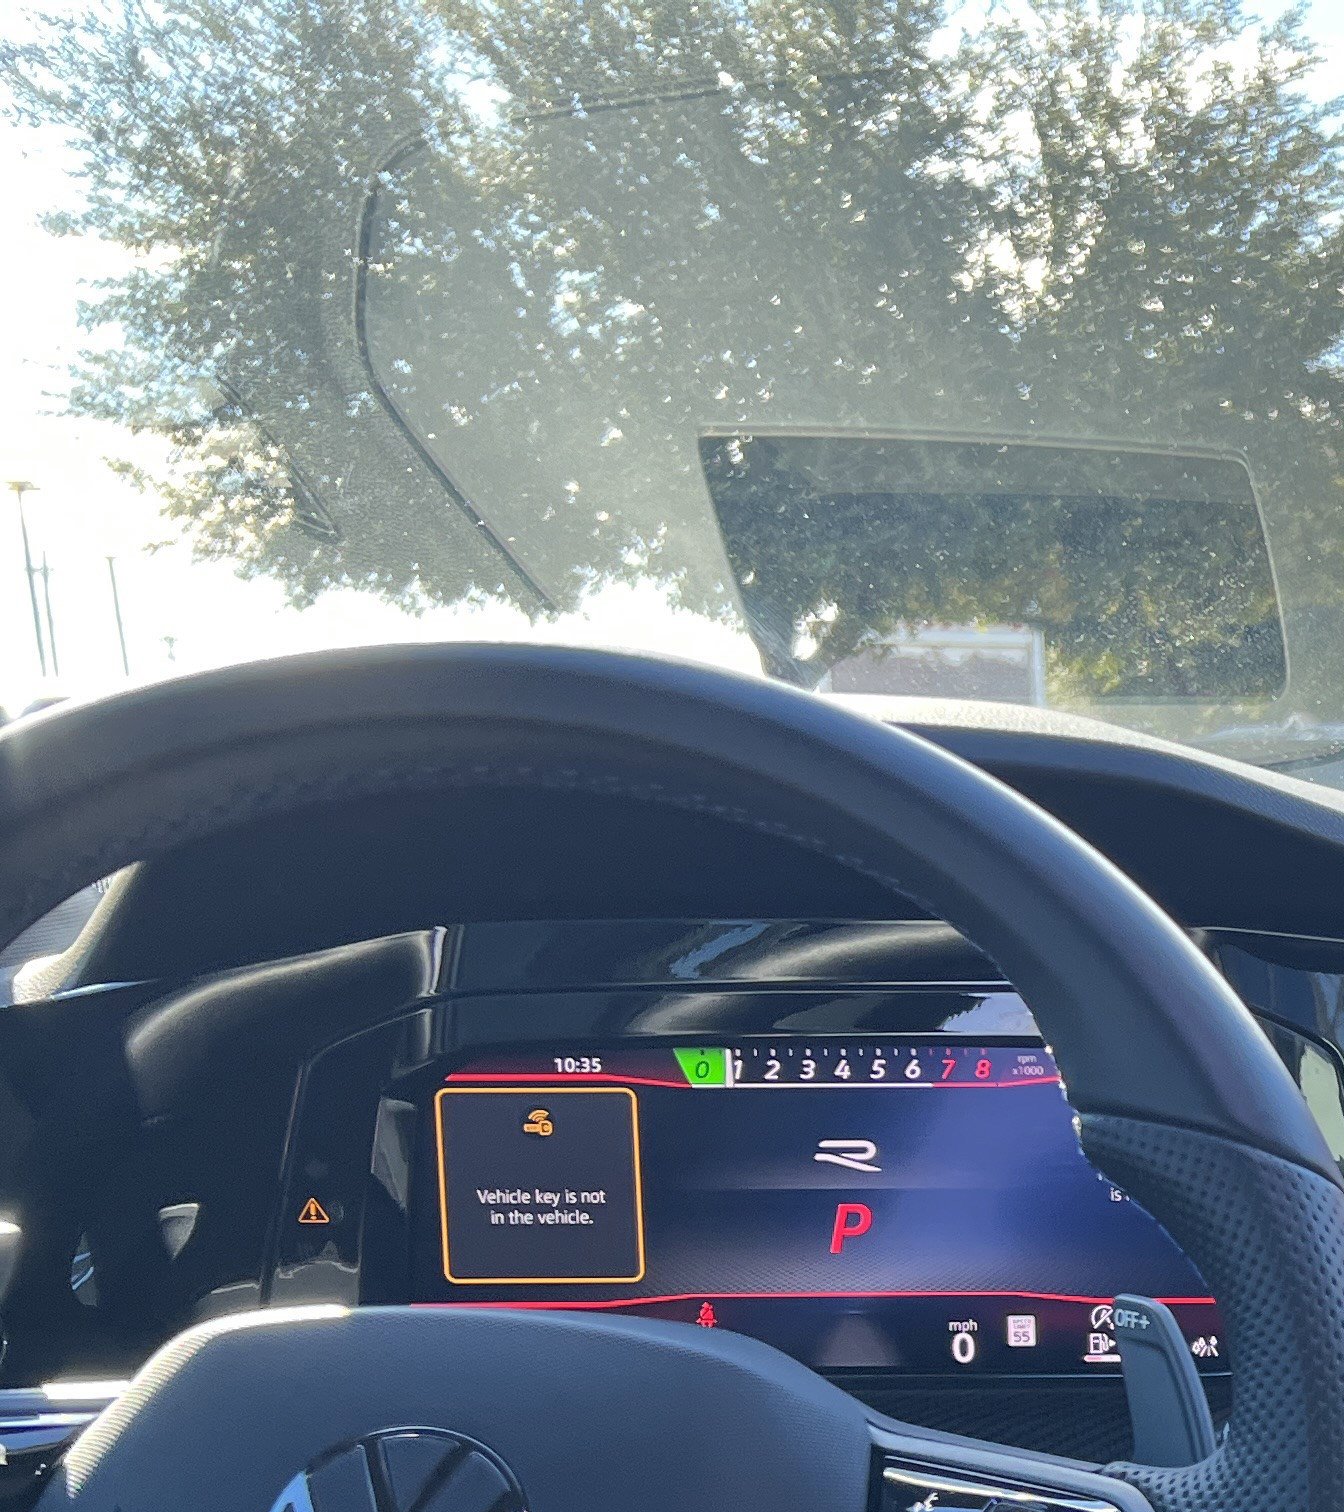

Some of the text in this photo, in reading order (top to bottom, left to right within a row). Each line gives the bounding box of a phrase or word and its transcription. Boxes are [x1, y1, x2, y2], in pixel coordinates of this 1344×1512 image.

[553, 1056, 602, 1073] 10:35
[694, 1059, 992, 1080] 0 1 2 3 4 5 6 7 8
[476, 1188, 606, 1208] Vehicle key is not
[490, 1209, 594, 1226] in the vehicle.
[829, 1202, 874, 1254] P
[948, 1318, 978, 1334] mph
[1012, 1330, 1031, 1343] 55
[951, 1332, 976, 1364] 0
